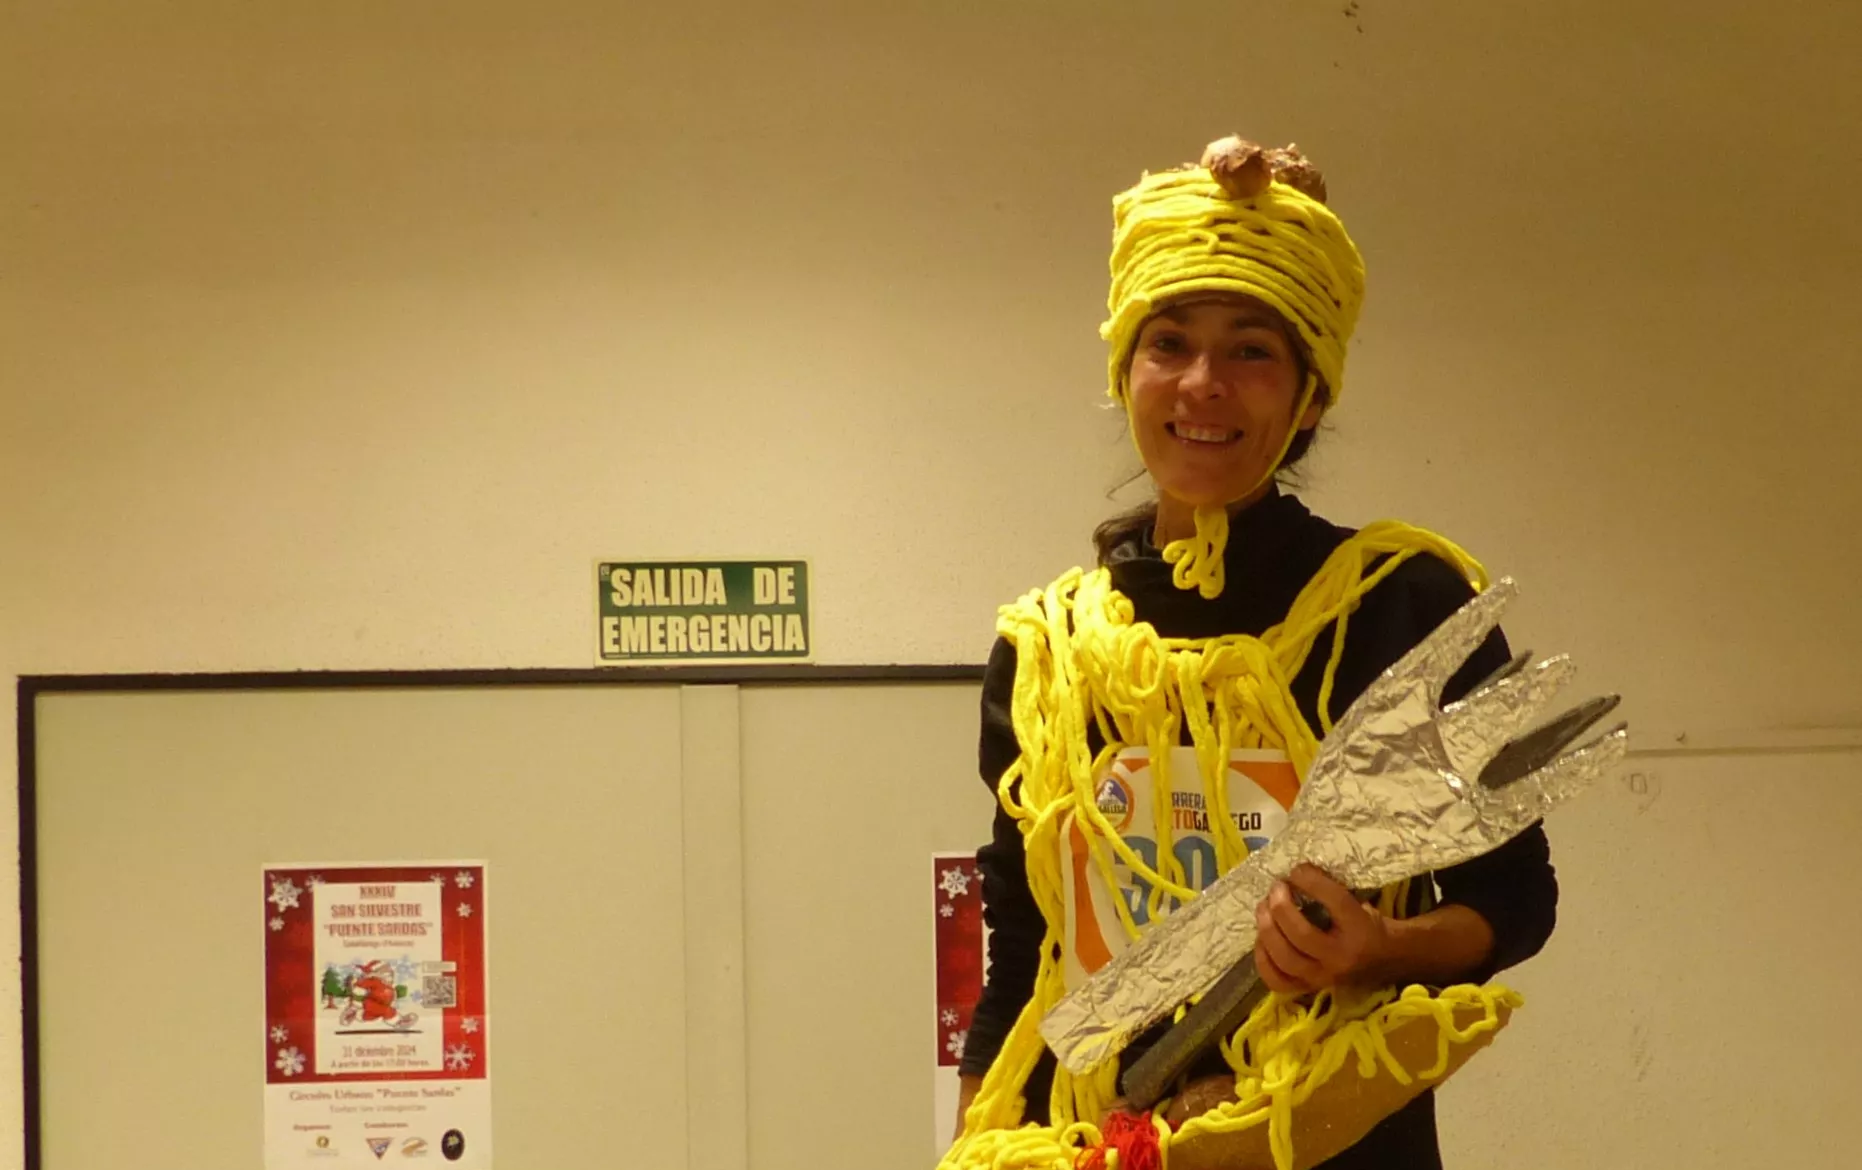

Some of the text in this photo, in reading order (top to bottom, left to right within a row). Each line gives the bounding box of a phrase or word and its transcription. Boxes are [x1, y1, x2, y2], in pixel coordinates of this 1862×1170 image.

[611, 567, 796, 606] SALIDA DE
[603, 614, 806, 653] EMERGENCIA
[1113, 836, 1269, 926] 30
[359, 903, 422, 917] SILVESTRE
